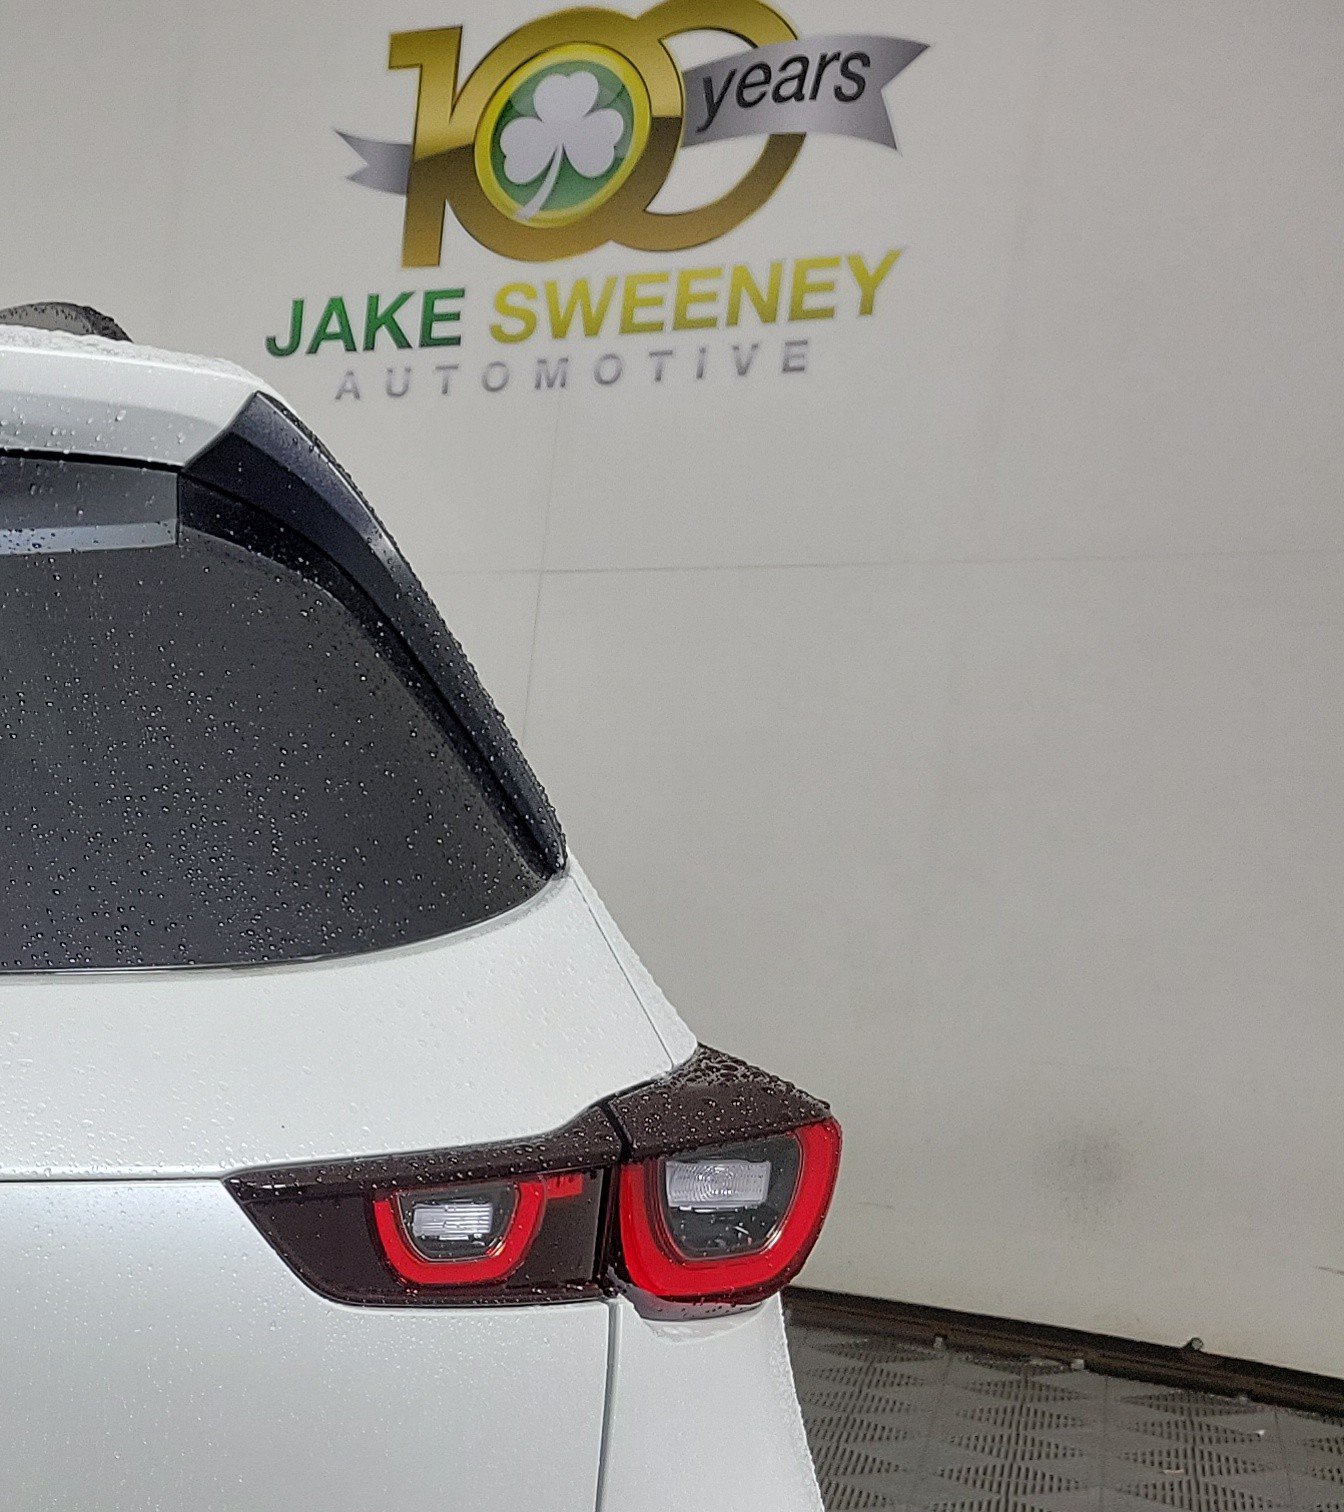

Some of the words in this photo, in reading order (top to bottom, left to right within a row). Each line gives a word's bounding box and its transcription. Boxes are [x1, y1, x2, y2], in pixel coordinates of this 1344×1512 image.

[388, 0, 808, 269] 100
[700, 48, 872, 131] years
[265, 288, 466, 357] JAKE
[489, 248, 904, 345] SWEENEY
[334, 339, 811, 402] AUTOMOTIVE
